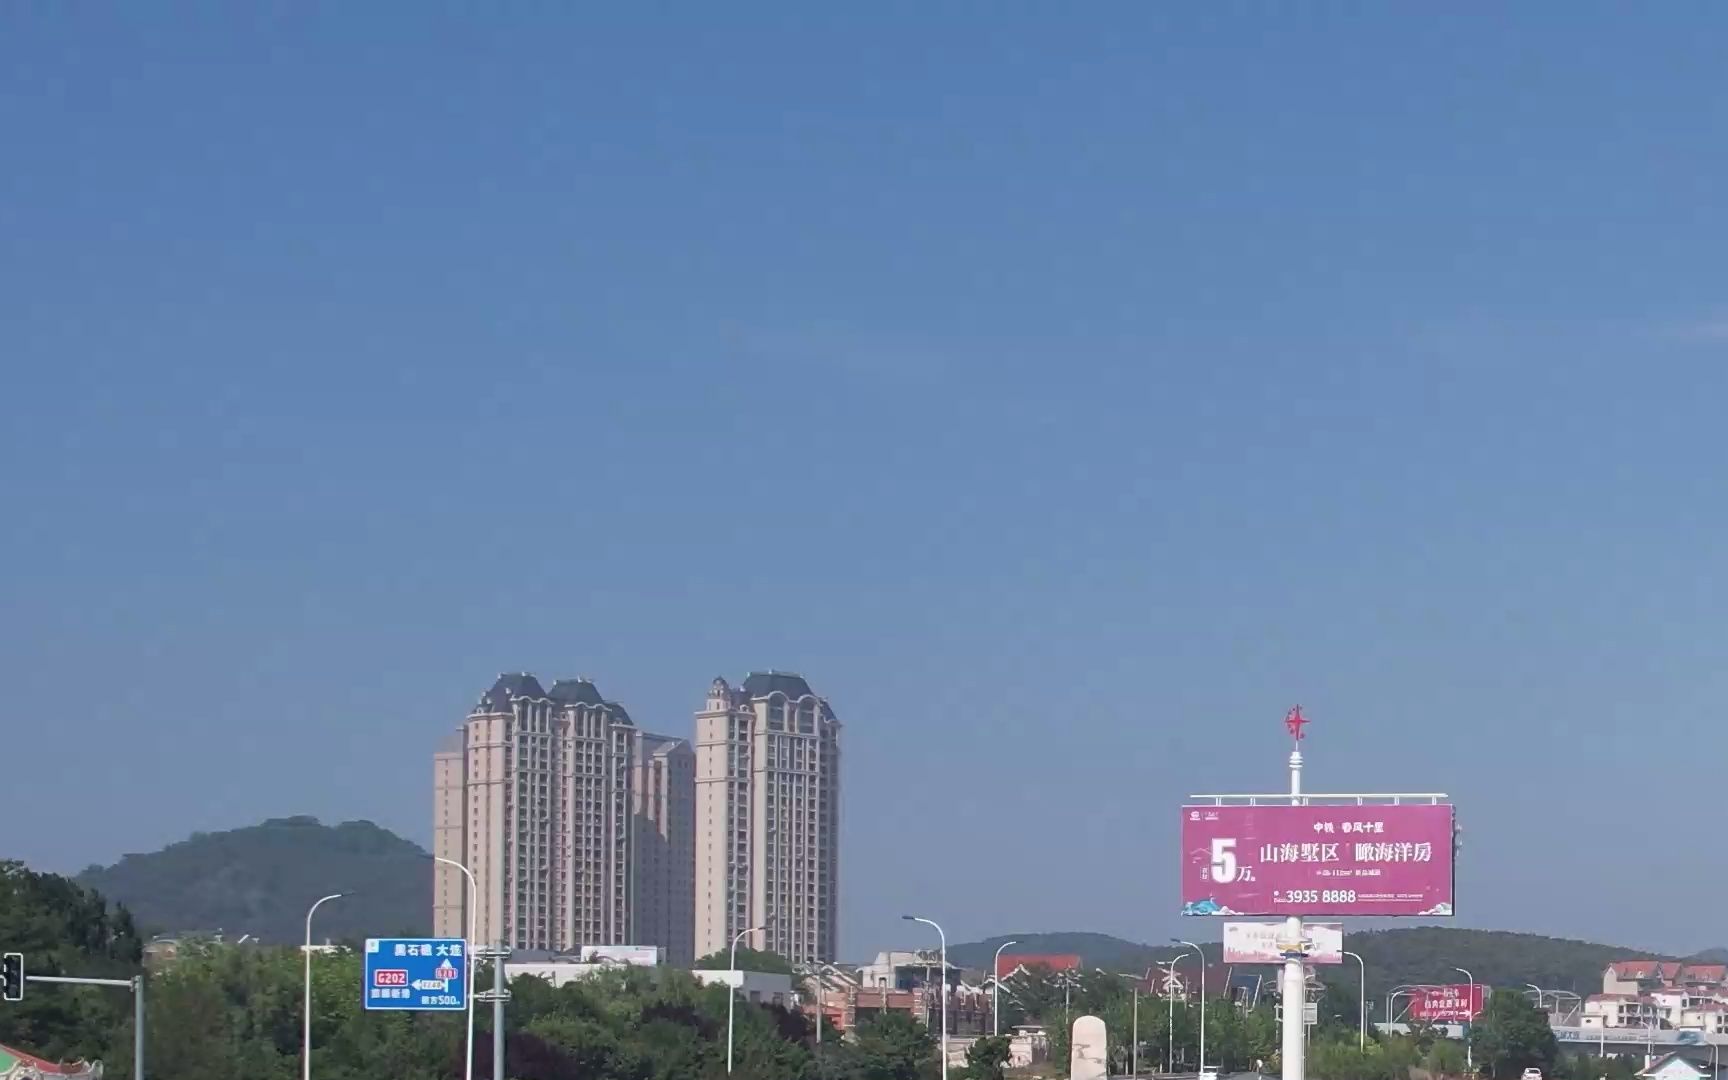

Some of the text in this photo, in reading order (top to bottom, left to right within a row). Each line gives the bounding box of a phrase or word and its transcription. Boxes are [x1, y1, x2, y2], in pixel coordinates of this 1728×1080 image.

[1260, 842, 1432, 863] 山海墅区 瞰海洋房
[1285, 890, 1318, 903] 3935
[1322, 890, 1356, 903] 8888
[436, 944, 462, 956] 大连
[378, 973, 406, 984] G202
